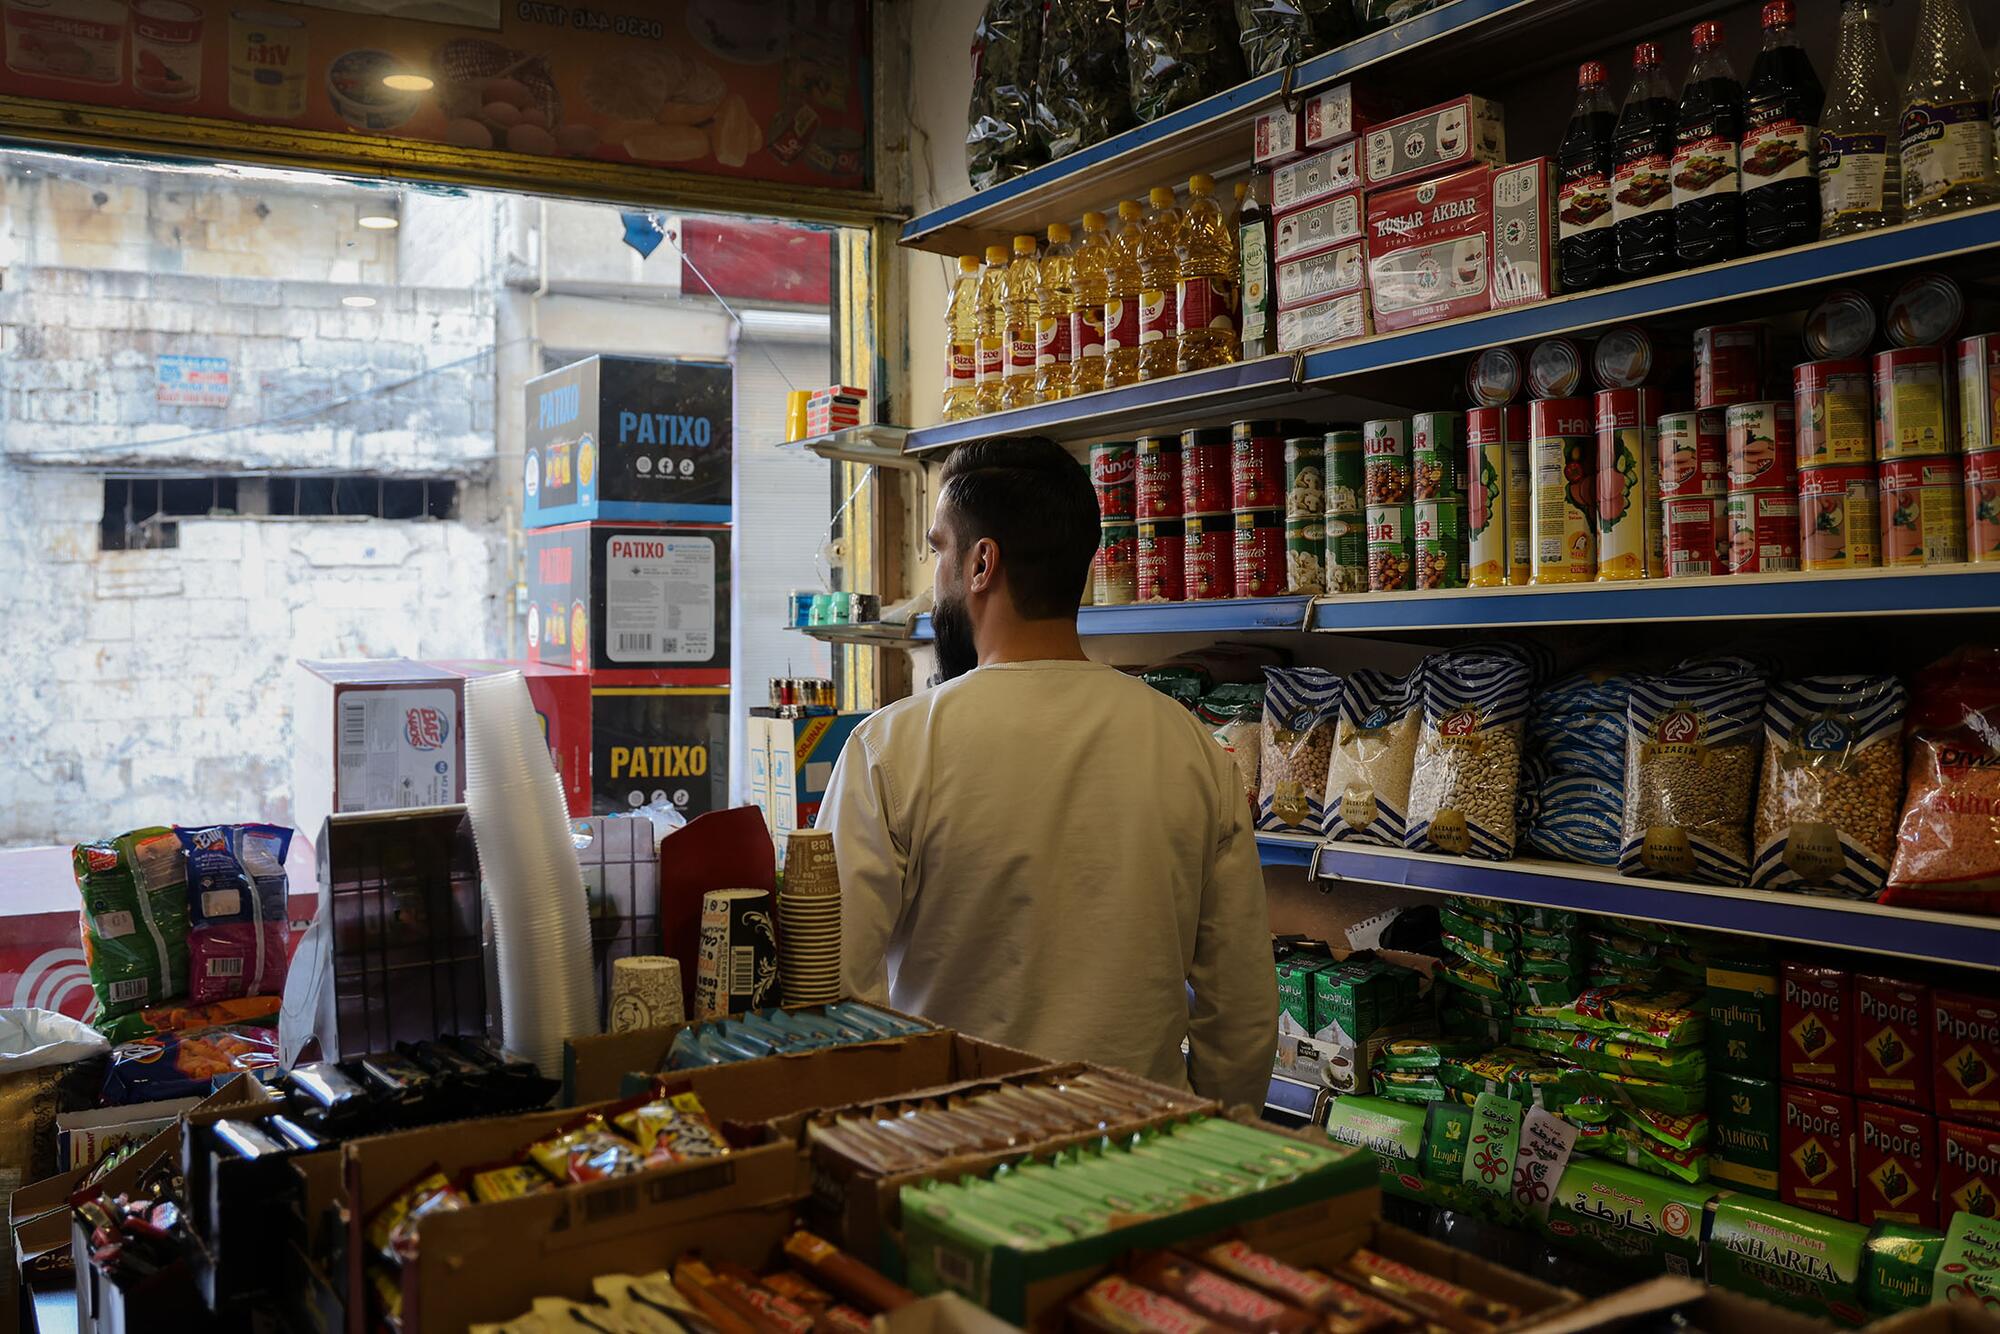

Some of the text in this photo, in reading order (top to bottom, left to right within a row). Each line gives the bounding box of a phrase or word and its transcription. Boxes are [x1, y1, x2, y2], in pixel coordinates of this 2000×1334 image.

[1749, 106, 1782, 123] NATTE
[1677, 123, 1712, 140] NATTE
[1625, 142, 1655, 157] NATTE
[1566, 162, 1594, 176] NATTE
[1431, 197, 1477, 224] AKBAR
[1412, 303, 1450, 318] BIRDS TEA
[953, 355, 976, 365] Bizc
[539, 383, 580, 432] PATIXO
[619, 411, 711, 448] PATIXO
[1558, 418, 1592, 434] HAN
[1369, 524, 1393, 541] UR
[611, 541, 664, 559] PATIXO
[796, 720, 828, 760] ORJINAL
[1649, 745, 1698, 757] ALZAEIM
[610, 744, 708, 780] PATIXO
[1717, 1124, 1769, 1152] SABROSA
[1946, 1138, 2000, 1175] Pipor
[1572, 1191, 1659, 1237] خارطة
[1726, 1230, 1839, 1285] KHARTA
